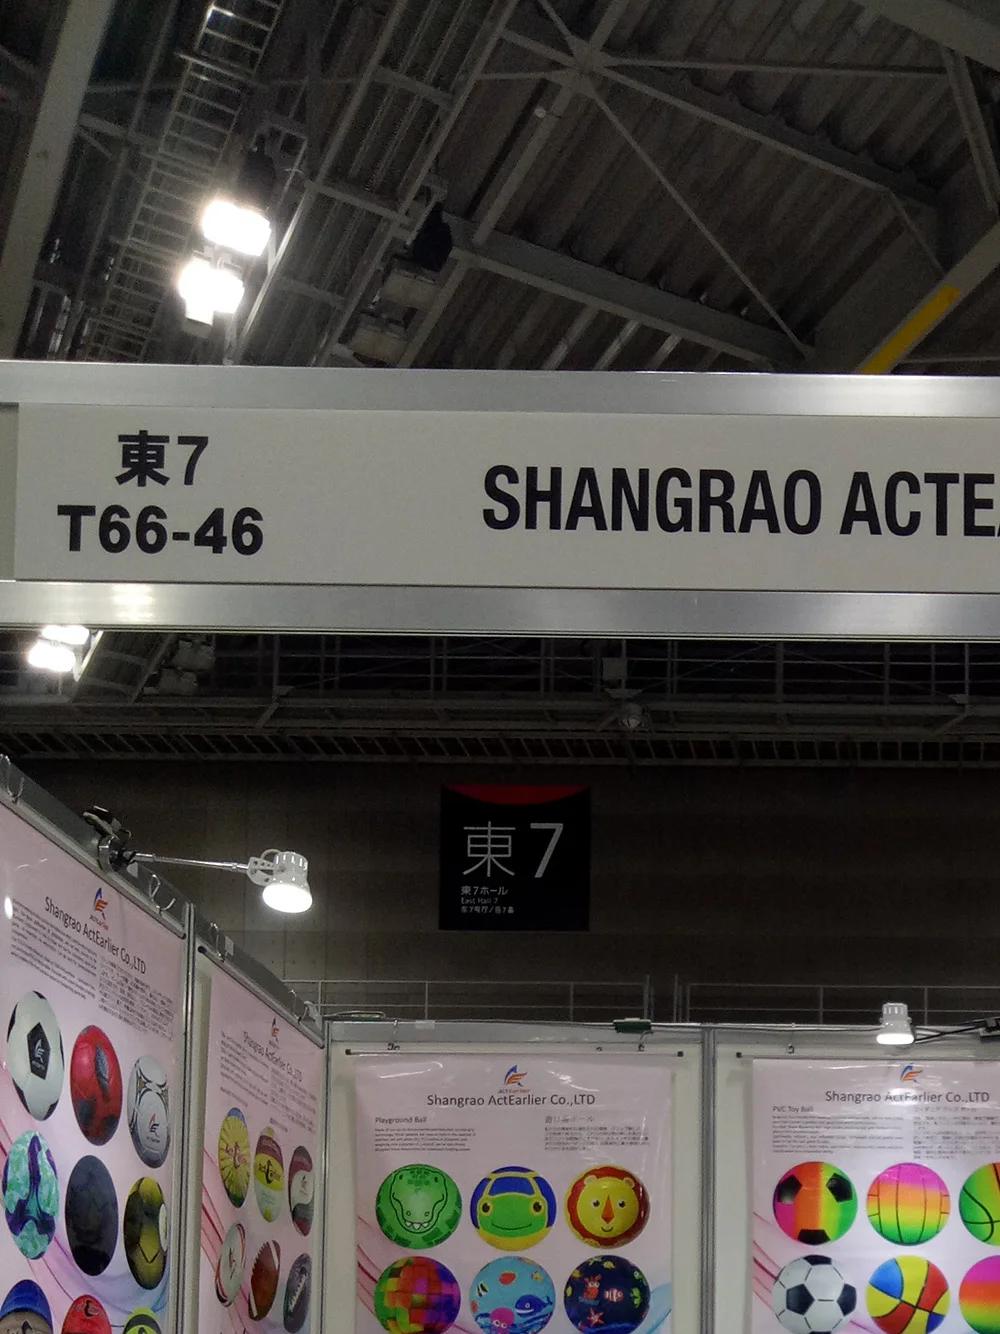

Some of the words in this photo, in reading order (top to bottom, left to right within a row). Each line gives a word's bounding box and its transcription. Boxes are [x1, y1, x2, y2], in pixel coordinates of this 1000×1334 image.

[115, 430, 210, 488] 東7
[482, 465, 823, 537] SHANGRAO
[57, 504, 264, 556] T66-46
[462, 821, 564, 878] 東7
[461, 885, 508, 896] 東7ホール
[44, 896, 82, 933] Shangrao
[82, 923, 120, 957] ActEarlier
[427, 1094, 485, 1108] Shangrao
[488, 1094, 547, 1106] ActEarlier
[550, 1094, 596, 1107] Co.,LTD
[772, 1105, 787, 1113] PVC
[787, 1105, 800, 1114] Toy
[801, 1105, 814, 1113] Ball
[825, 1090, 882, 1104] Shangrao
[945, 1091, 990, 1103] Co.,LTD
[374, 1116, 413, 1125] Playground
